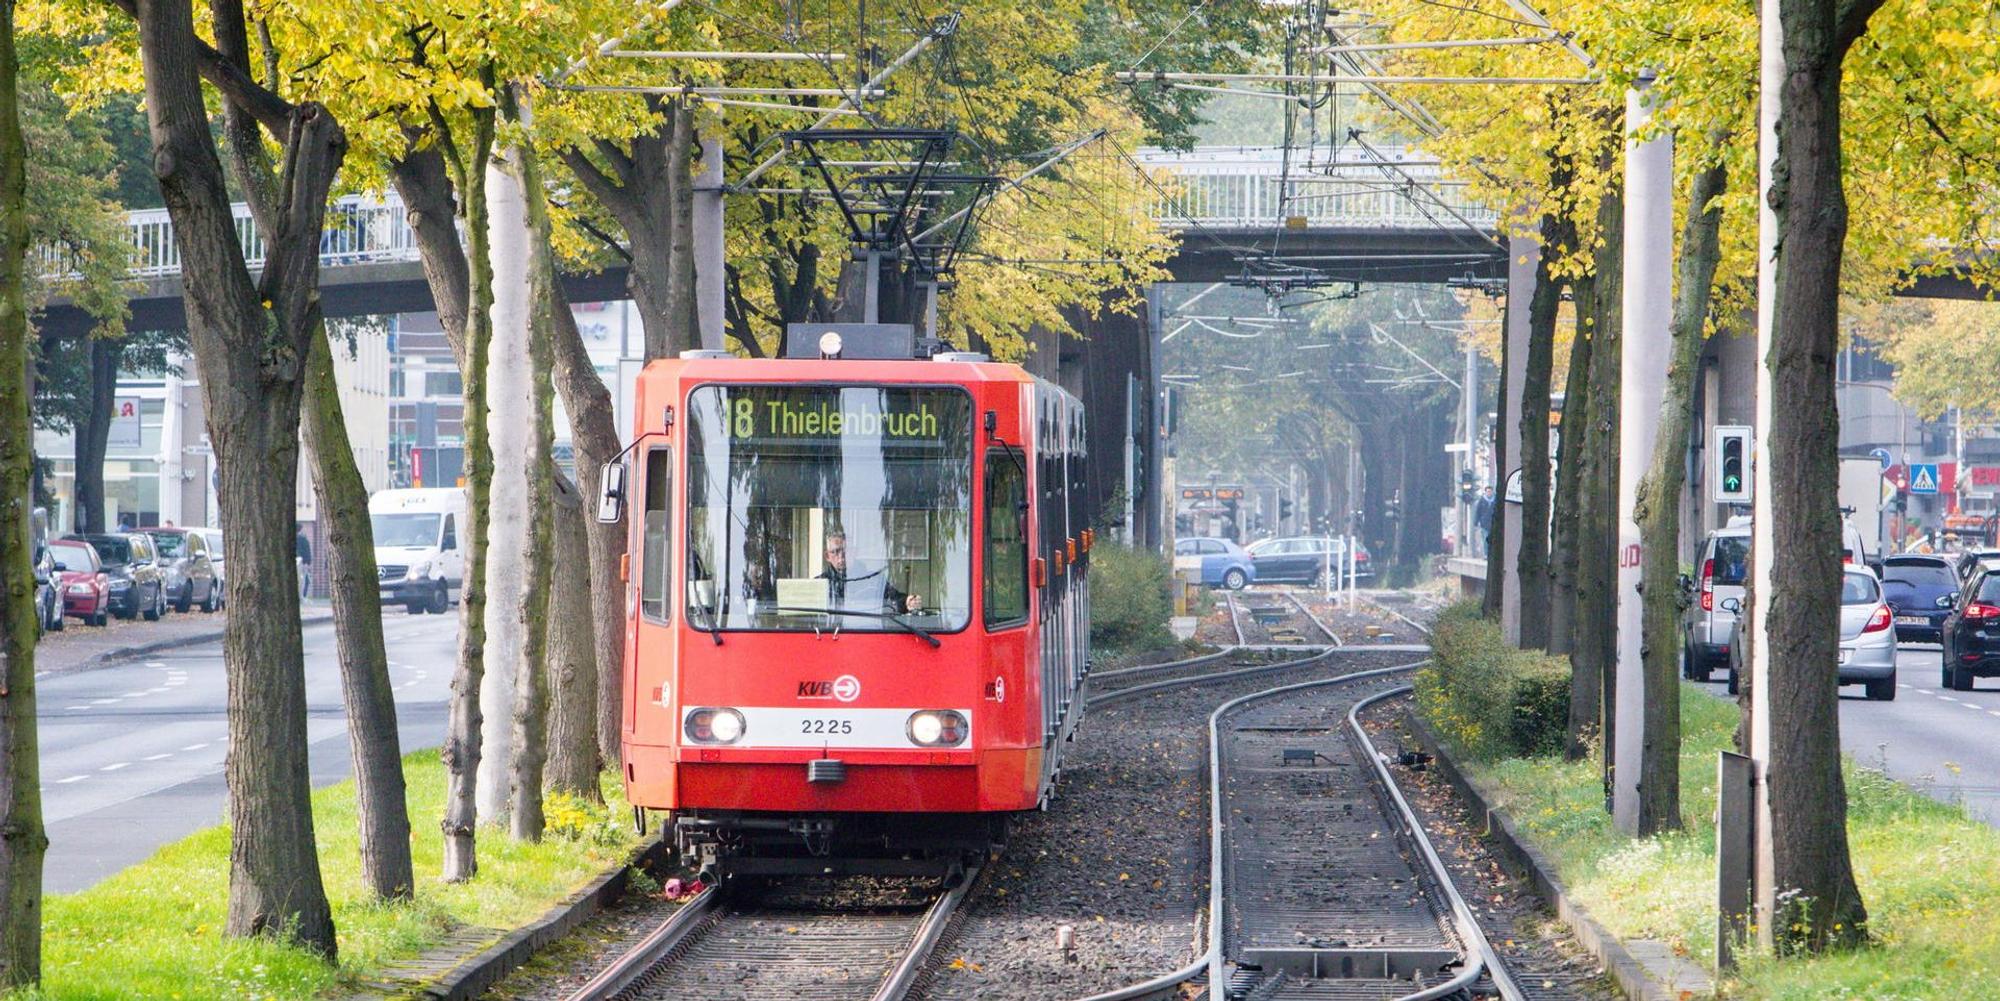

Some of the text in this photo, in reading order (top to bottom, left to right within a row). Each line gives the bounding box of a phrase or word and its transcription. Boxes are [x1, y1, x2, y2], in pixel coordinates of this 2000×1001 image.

[726, 398, 937, 438] 18 Thielenbruch
[798, 681, 833, 696] KVB
[802, 719, 852, 735] 2225
